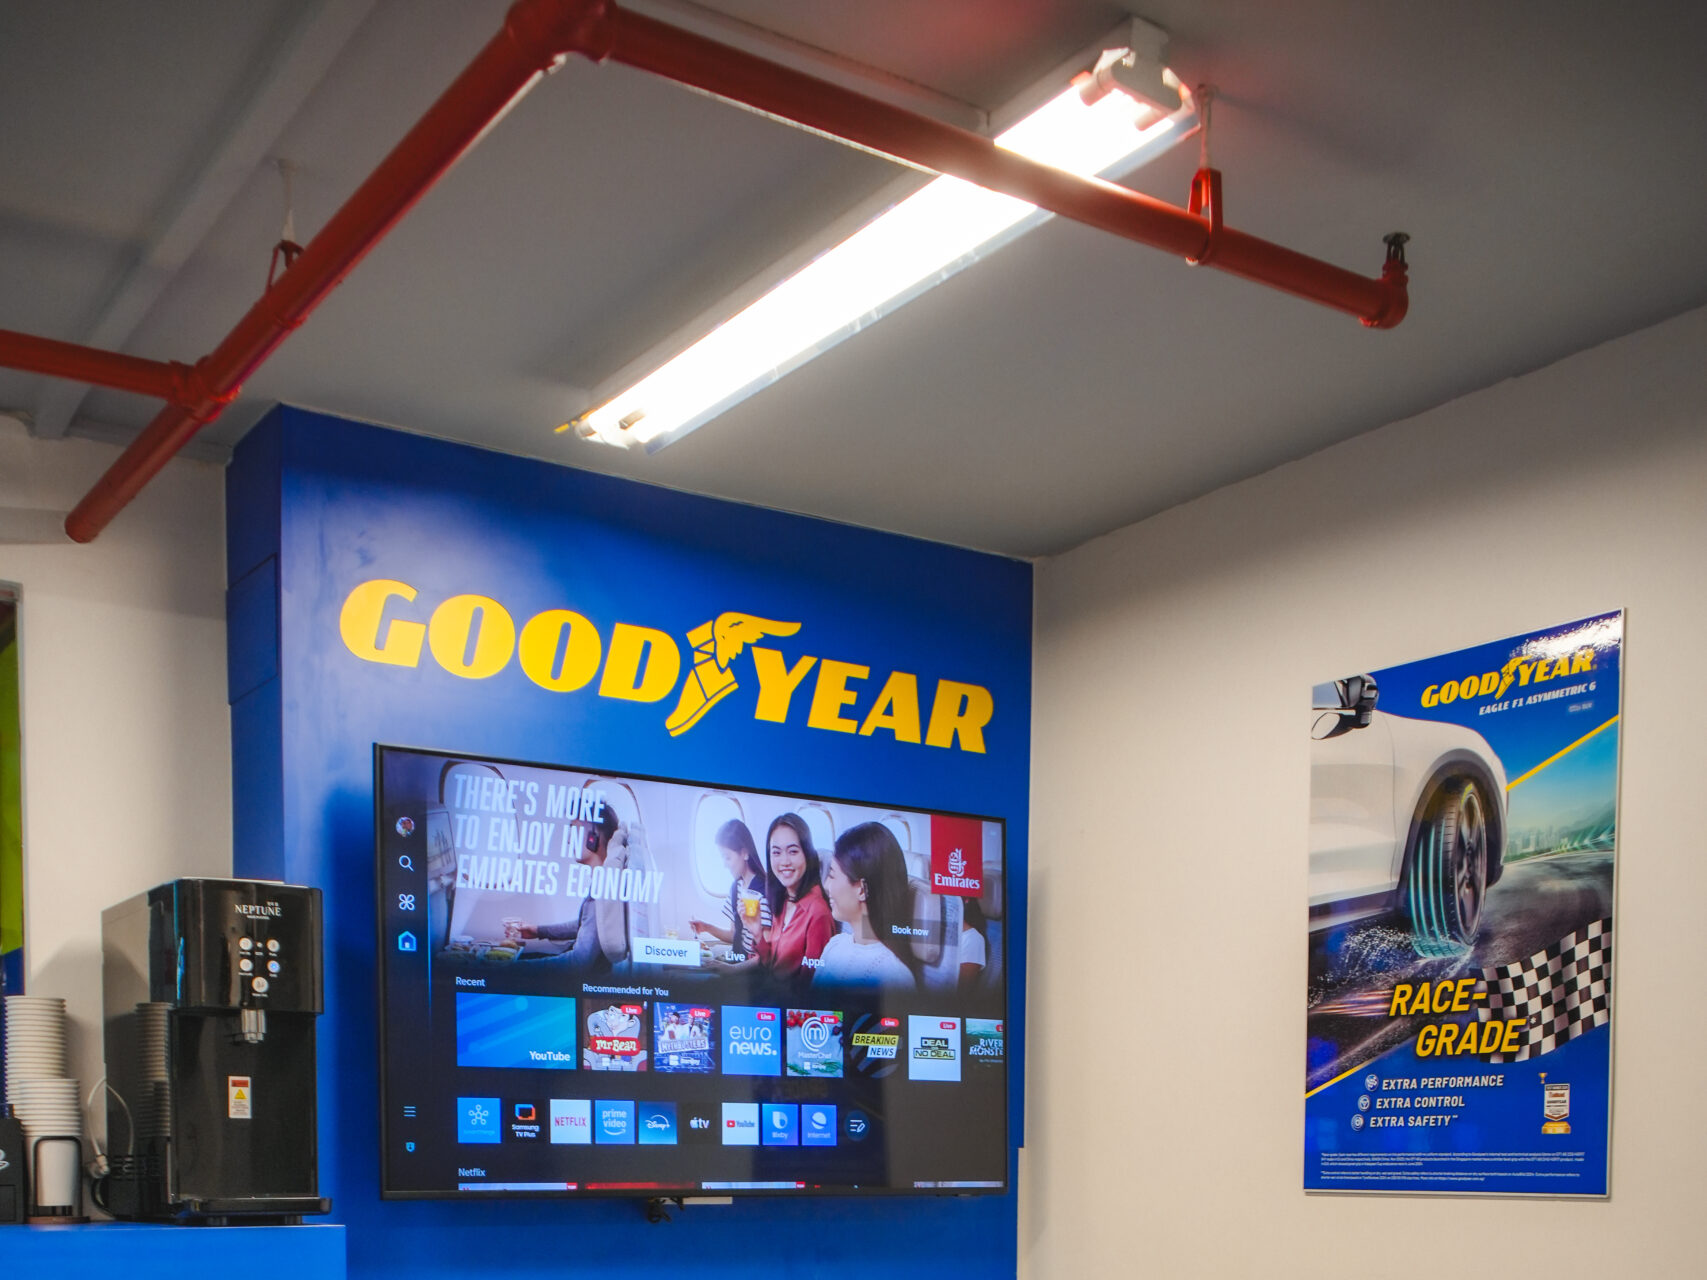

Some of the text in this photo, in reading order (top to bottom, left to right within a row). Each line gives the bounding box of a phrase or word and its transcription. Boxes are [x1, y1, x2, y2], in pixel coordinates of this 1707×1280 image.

[340, 579, 993, 753] GOODYEAR
[1479, 682, 1596, 715] EAGLE F1 ASYMMETRIC 6
[454, 774, 607, 823] THERE'S MORE
[455, 814, 585, 860] TO ENJOY IN
[456, 854, 664, 904] EMIRATES ECONOMY
[934, 873, 980, 889] Emirates
[234, 904, 282, 917] NEPTUNE
[891, 925, 929, 937] Book now
[645, 945, 687, 958] Discover
[725, 952, 746, 962] Live
[801, 956, 825, 969] Apps
[456, 977, 485, 987] Recent
[582, 984, 669, 997] Recommended for You
[1389, 977, 1487, 1017] RACE-
[625, 1006, 638, 1014] Live
[729, 1025, 772, 1041] euro
[854, 1035, 896, 1045] BREAKING
[921, 1039, 948, 1047] DEAL
[729, 1041, 778, 1056] news.
[870, 1047, 894, 1057] NEWS
[930, 1050, 954, 1058] DEAL
[529, 1050, 571, 1062] YouTube
[1382, 1075, 1504, 1090] EXTRA PERFORMANCE
[1376, 1095, 1465, 1109] EXTRA CONTROL
[602, 1108, 627, 1119] prime
[554, 1116, 587, 1127] NETFLIX
[603, 1118, 627, 1128] video
[736, 1120, 755, 1128] YouTube
[1369, 1116, 1405, 1128] EXTRA
[511, 1123, 540, 1133] Samsung
[458, 1168, 486, 1178] Netflix
